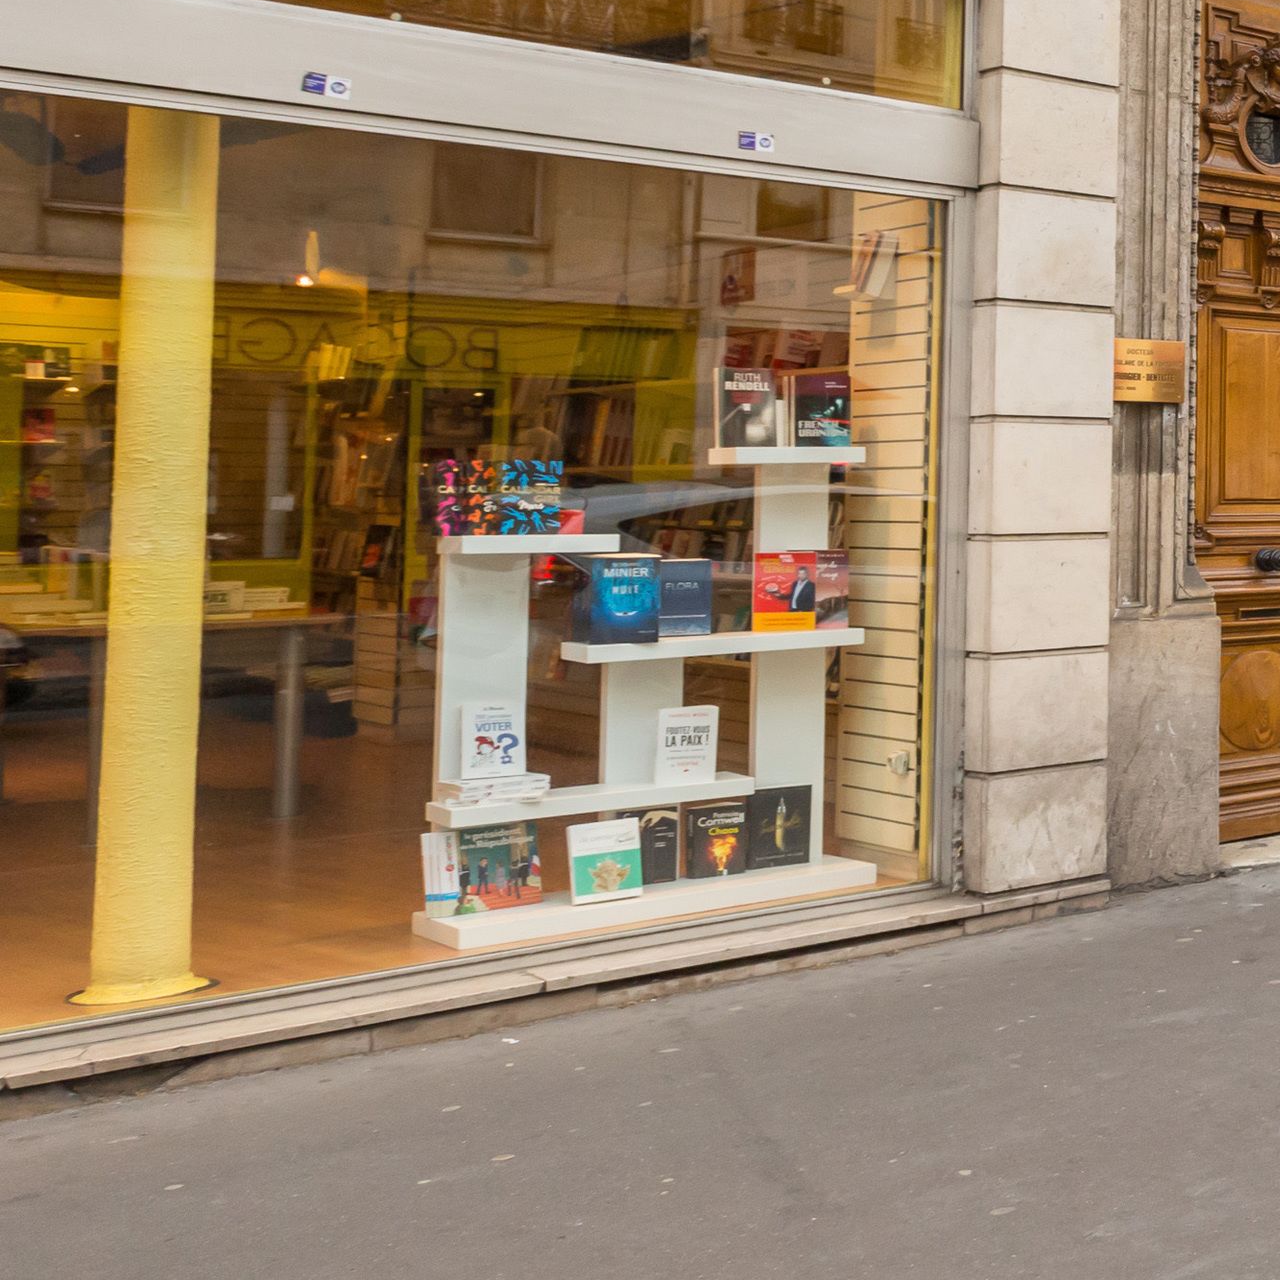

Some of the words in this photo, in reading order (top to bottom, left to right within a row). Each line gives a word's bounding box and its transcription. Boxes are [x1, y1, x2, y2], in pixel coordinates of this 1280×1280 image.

[734, 372, 761, 382] RUTH
[724, 380, 771, 392] RENDELL
[603, 567, 650, 578] MINIER
[612, 584, 639, 595] NUIT
[665, 581, 700, 592] FLORA
[475, 721, 513, 733] VOTER
[665, 735, 677, 747] LA
[680, 734, 703, 747] PAIX
[697, 812, 745, 827] Cornwell
[708, 827, 739, 836] Chaos
